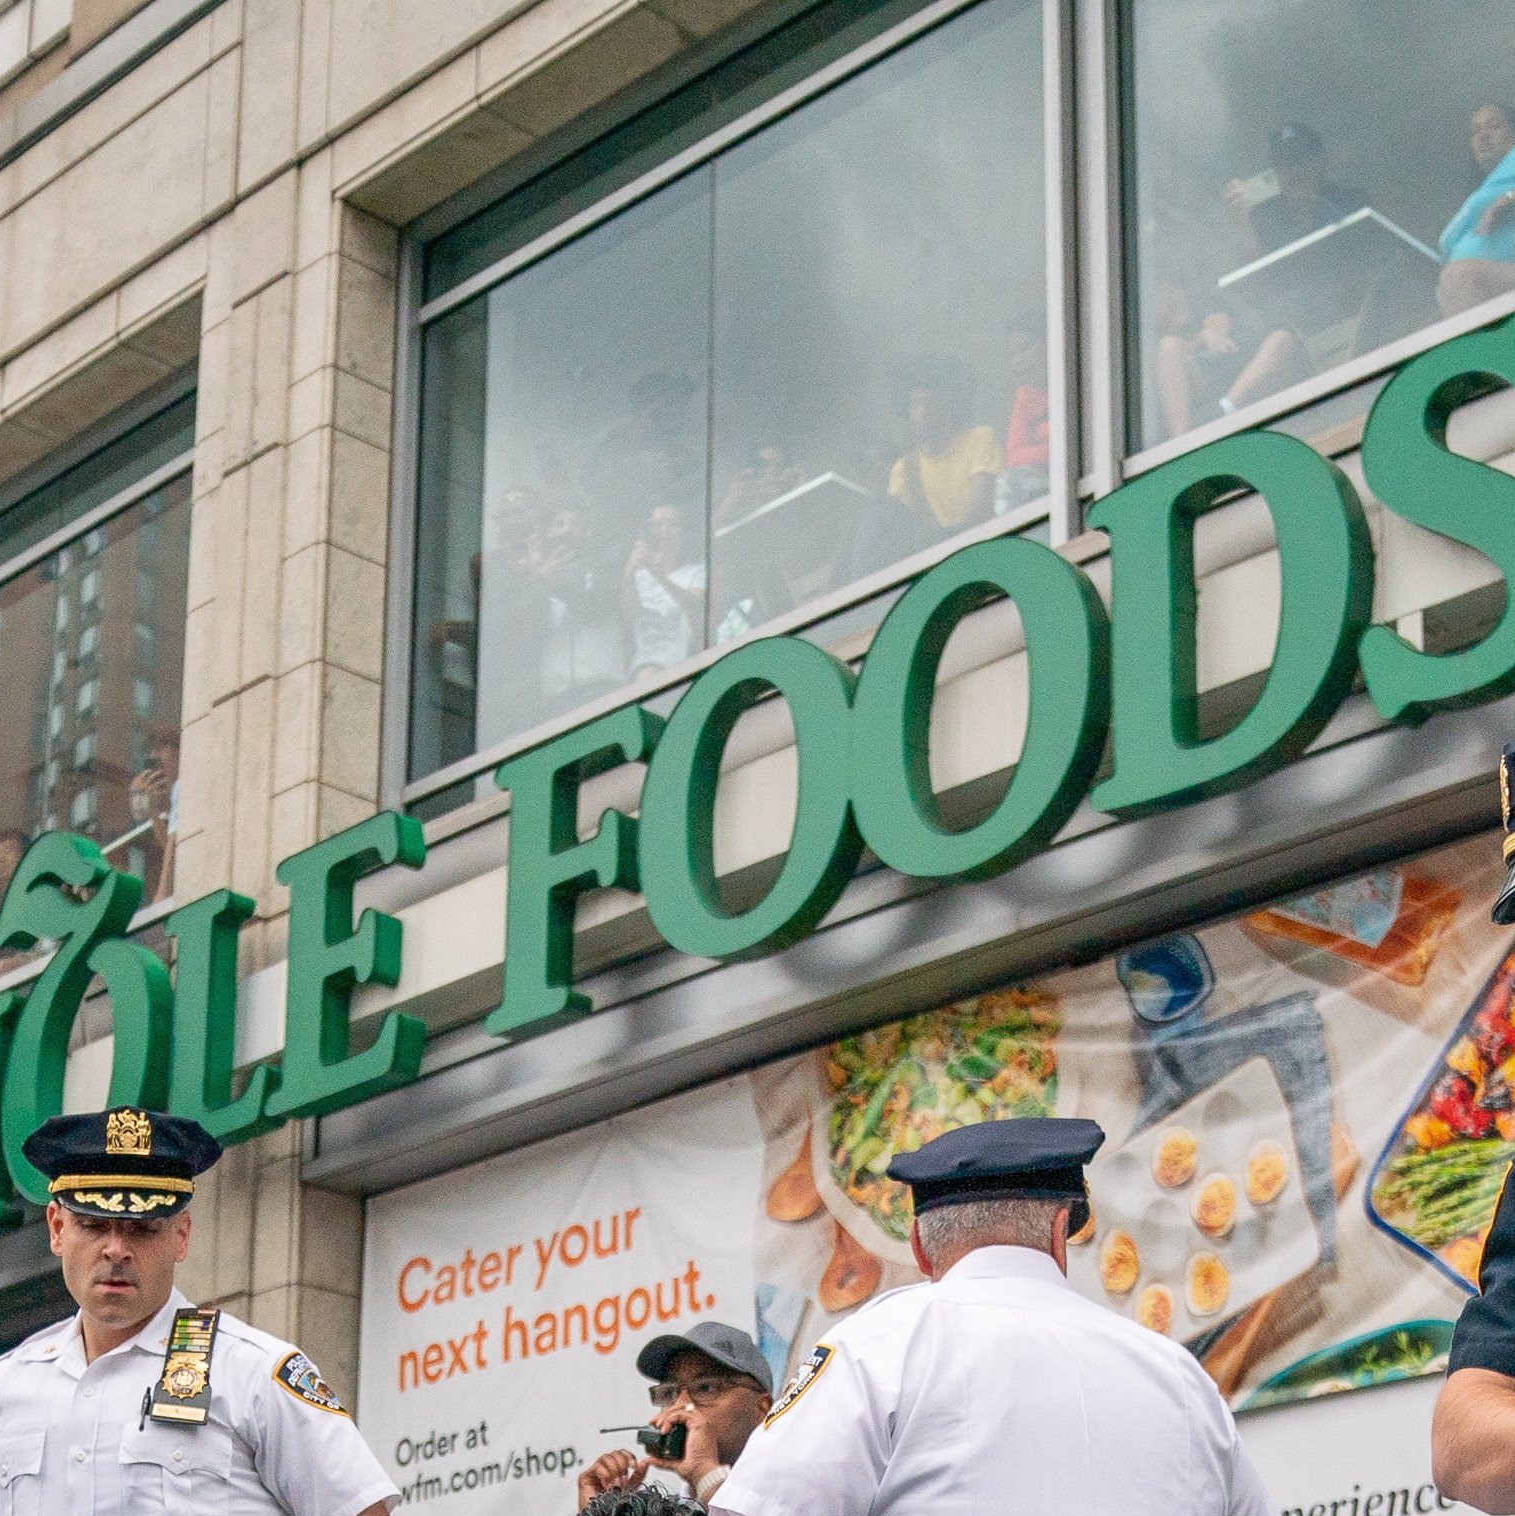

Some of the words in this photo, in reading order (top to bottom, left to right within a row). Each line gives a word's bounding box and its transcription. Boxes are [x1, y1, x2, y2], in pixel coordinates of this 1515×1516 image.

[397, 1241, 522, 1314] Cater
[532, 1207, 642, 1293] your
[397, 1319, 489, 1392] next
[501, 1259, 716, 1363] hangout.
[395, 1431, 460, 1468] Order
[465, 1421, 489, 1448] at
